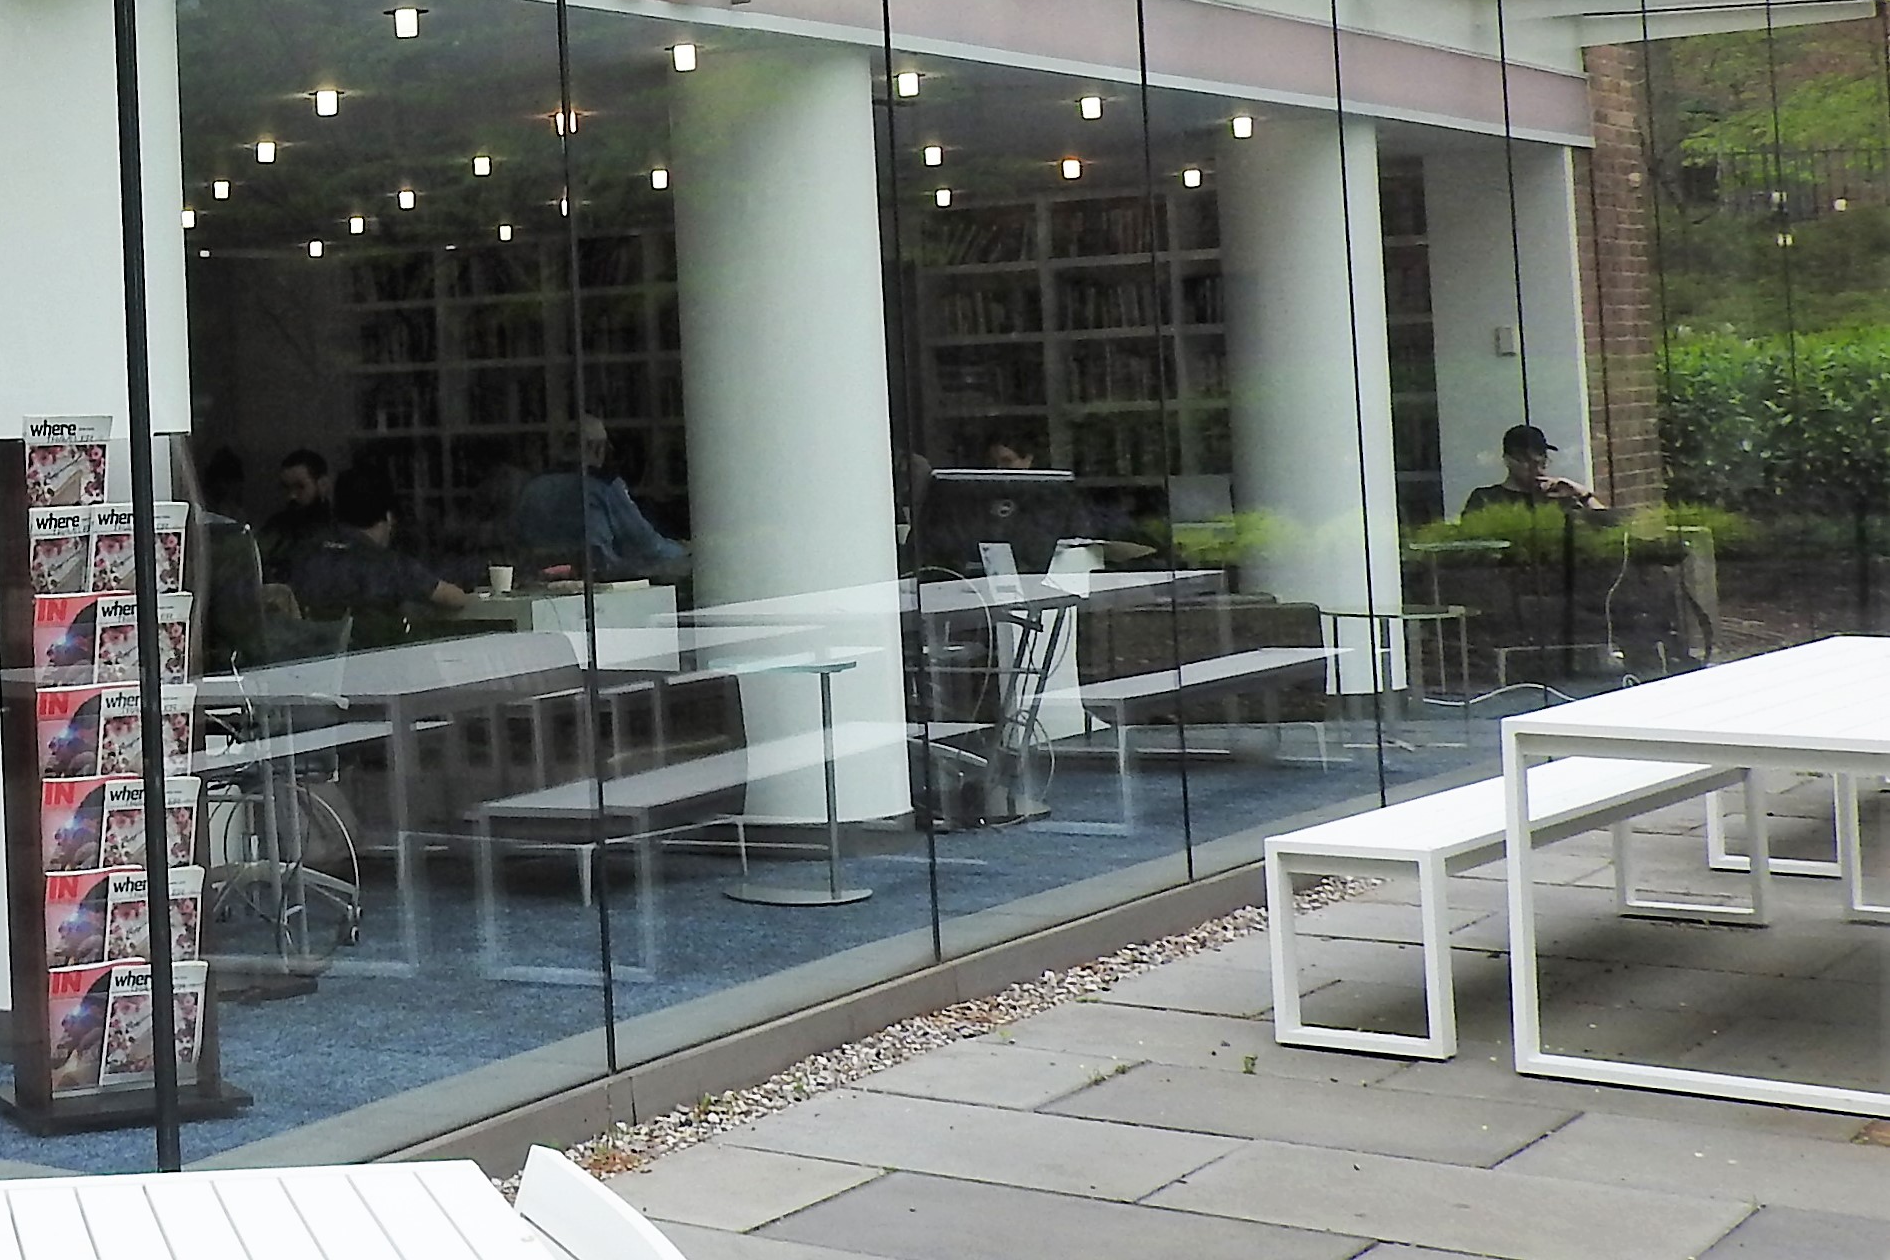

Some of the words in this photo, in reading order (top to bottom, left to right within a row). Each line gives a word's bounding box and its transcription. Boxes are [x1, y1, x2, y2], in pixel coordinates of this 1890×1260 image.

[30, 419, 77, 437] where
[36, 512, 80, 530] where
[97, 509, 134, 526] wher
[36, 600, 67, 622] IN
[101, 601, 136, 618] wher
[38, 692, 70, 715] IN
[105, 691, 140, 708] wher
[44, 782, 75, 805] IN
[109, 785, 144, 802] wher
[48, 876, 79, 899] IN
[113, 876, 146, 893] wher
[52, 971, 82, 994] IN
[115, 970, 151, 987] wher
